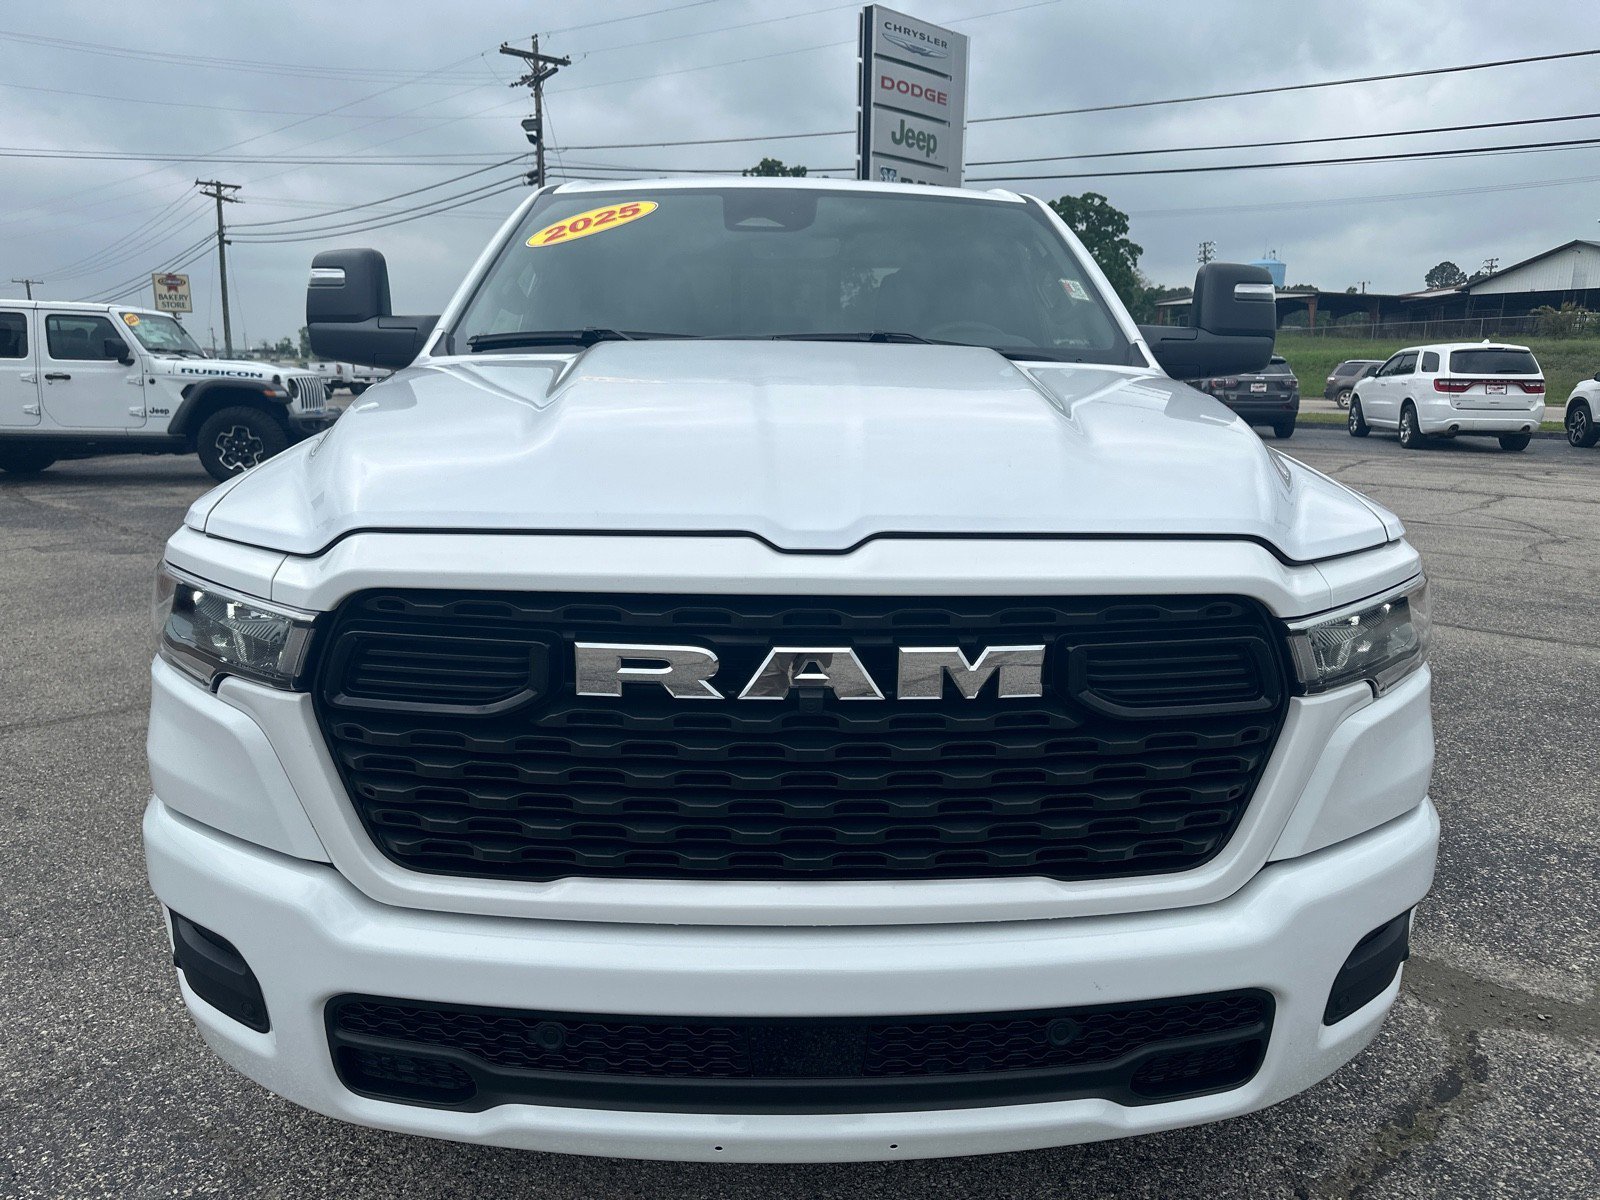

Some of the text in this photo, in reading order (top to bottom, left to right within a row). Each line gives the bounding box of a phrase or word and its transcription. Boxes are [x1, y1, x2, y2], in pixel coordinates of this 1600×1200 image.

[884, 21, 948, 49] CHRYSLER
[880, 75, 948, 106] DODGE
[891, 119, 938, 158] Jeep
[543, 203, 641, 243] 2025
[158, 293, 188, 302] BAKERY
[161, 301, 187, 309] STORE
[181, 368, 263, 379] RUBICON
[149, 406, 169, 415] Jeep
[574, 641, 1046, 701] RAM
